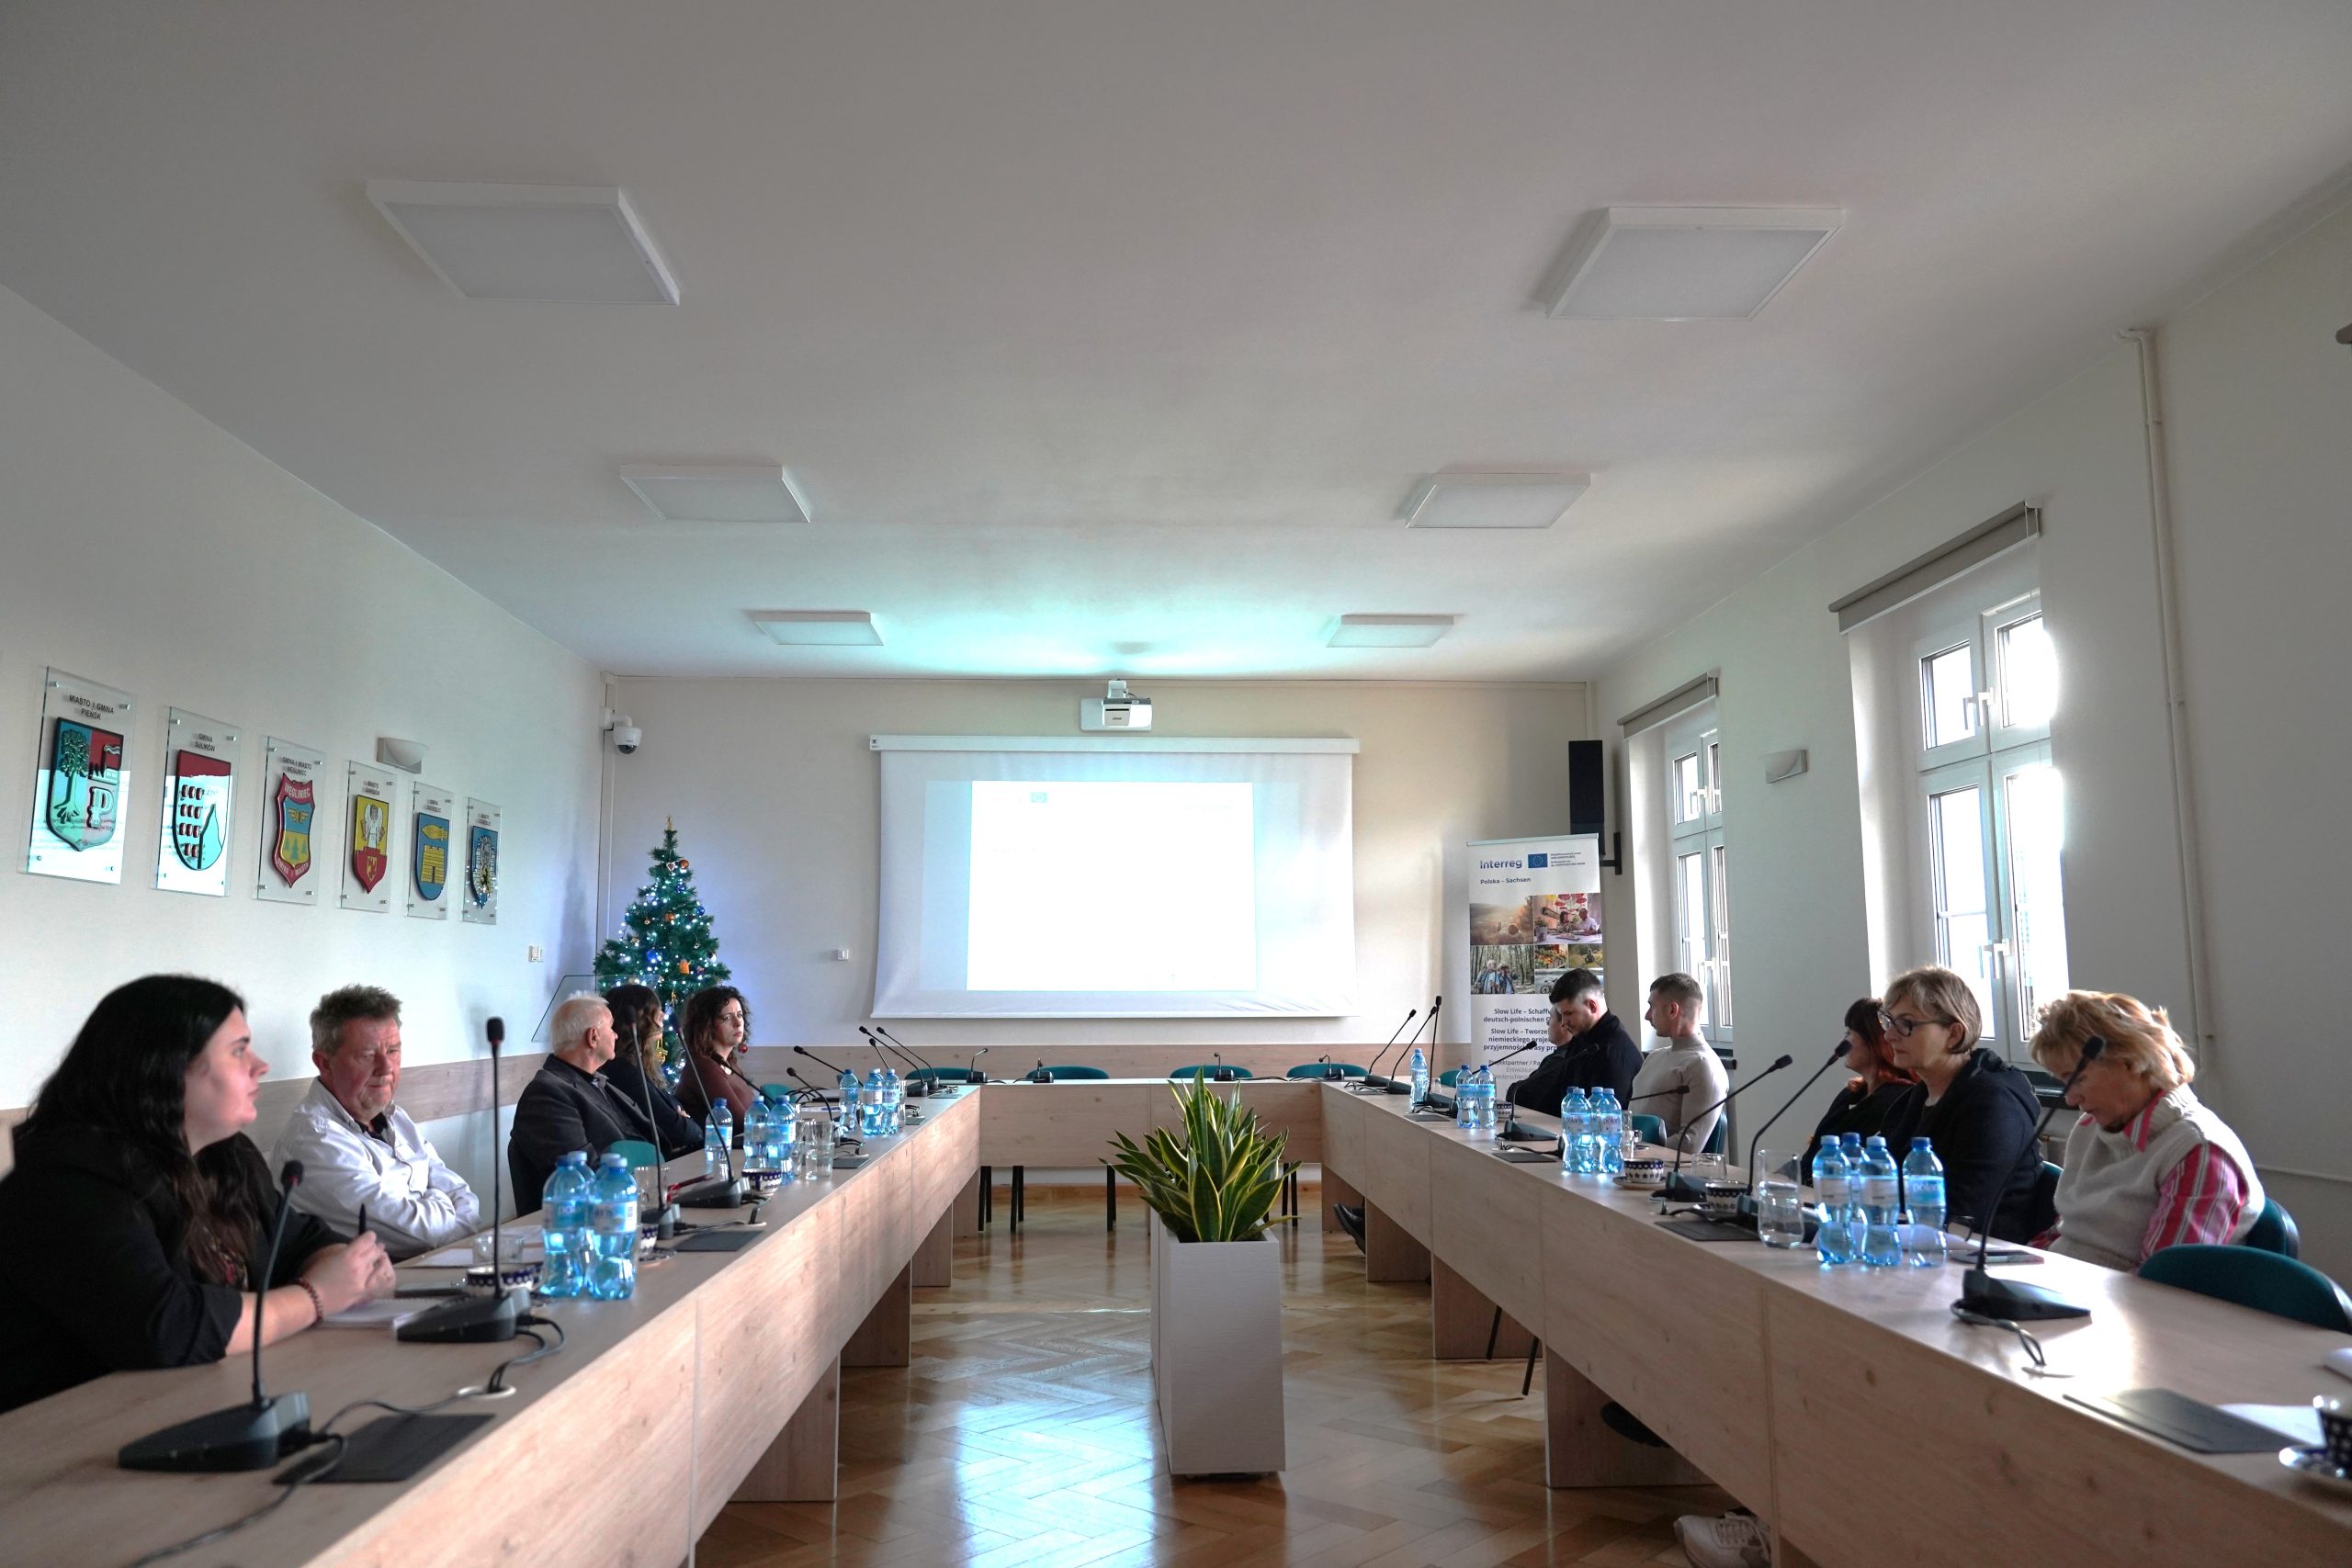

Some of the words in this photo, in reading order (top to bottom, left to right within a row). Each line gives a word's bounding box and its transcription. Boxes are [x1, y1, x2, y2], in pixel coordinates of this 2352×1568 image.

[69, 694, 91, 707] MIASTO
[96, 703, 114, 715] GMINA
[1480, 860, 1522, 870] Interreg
